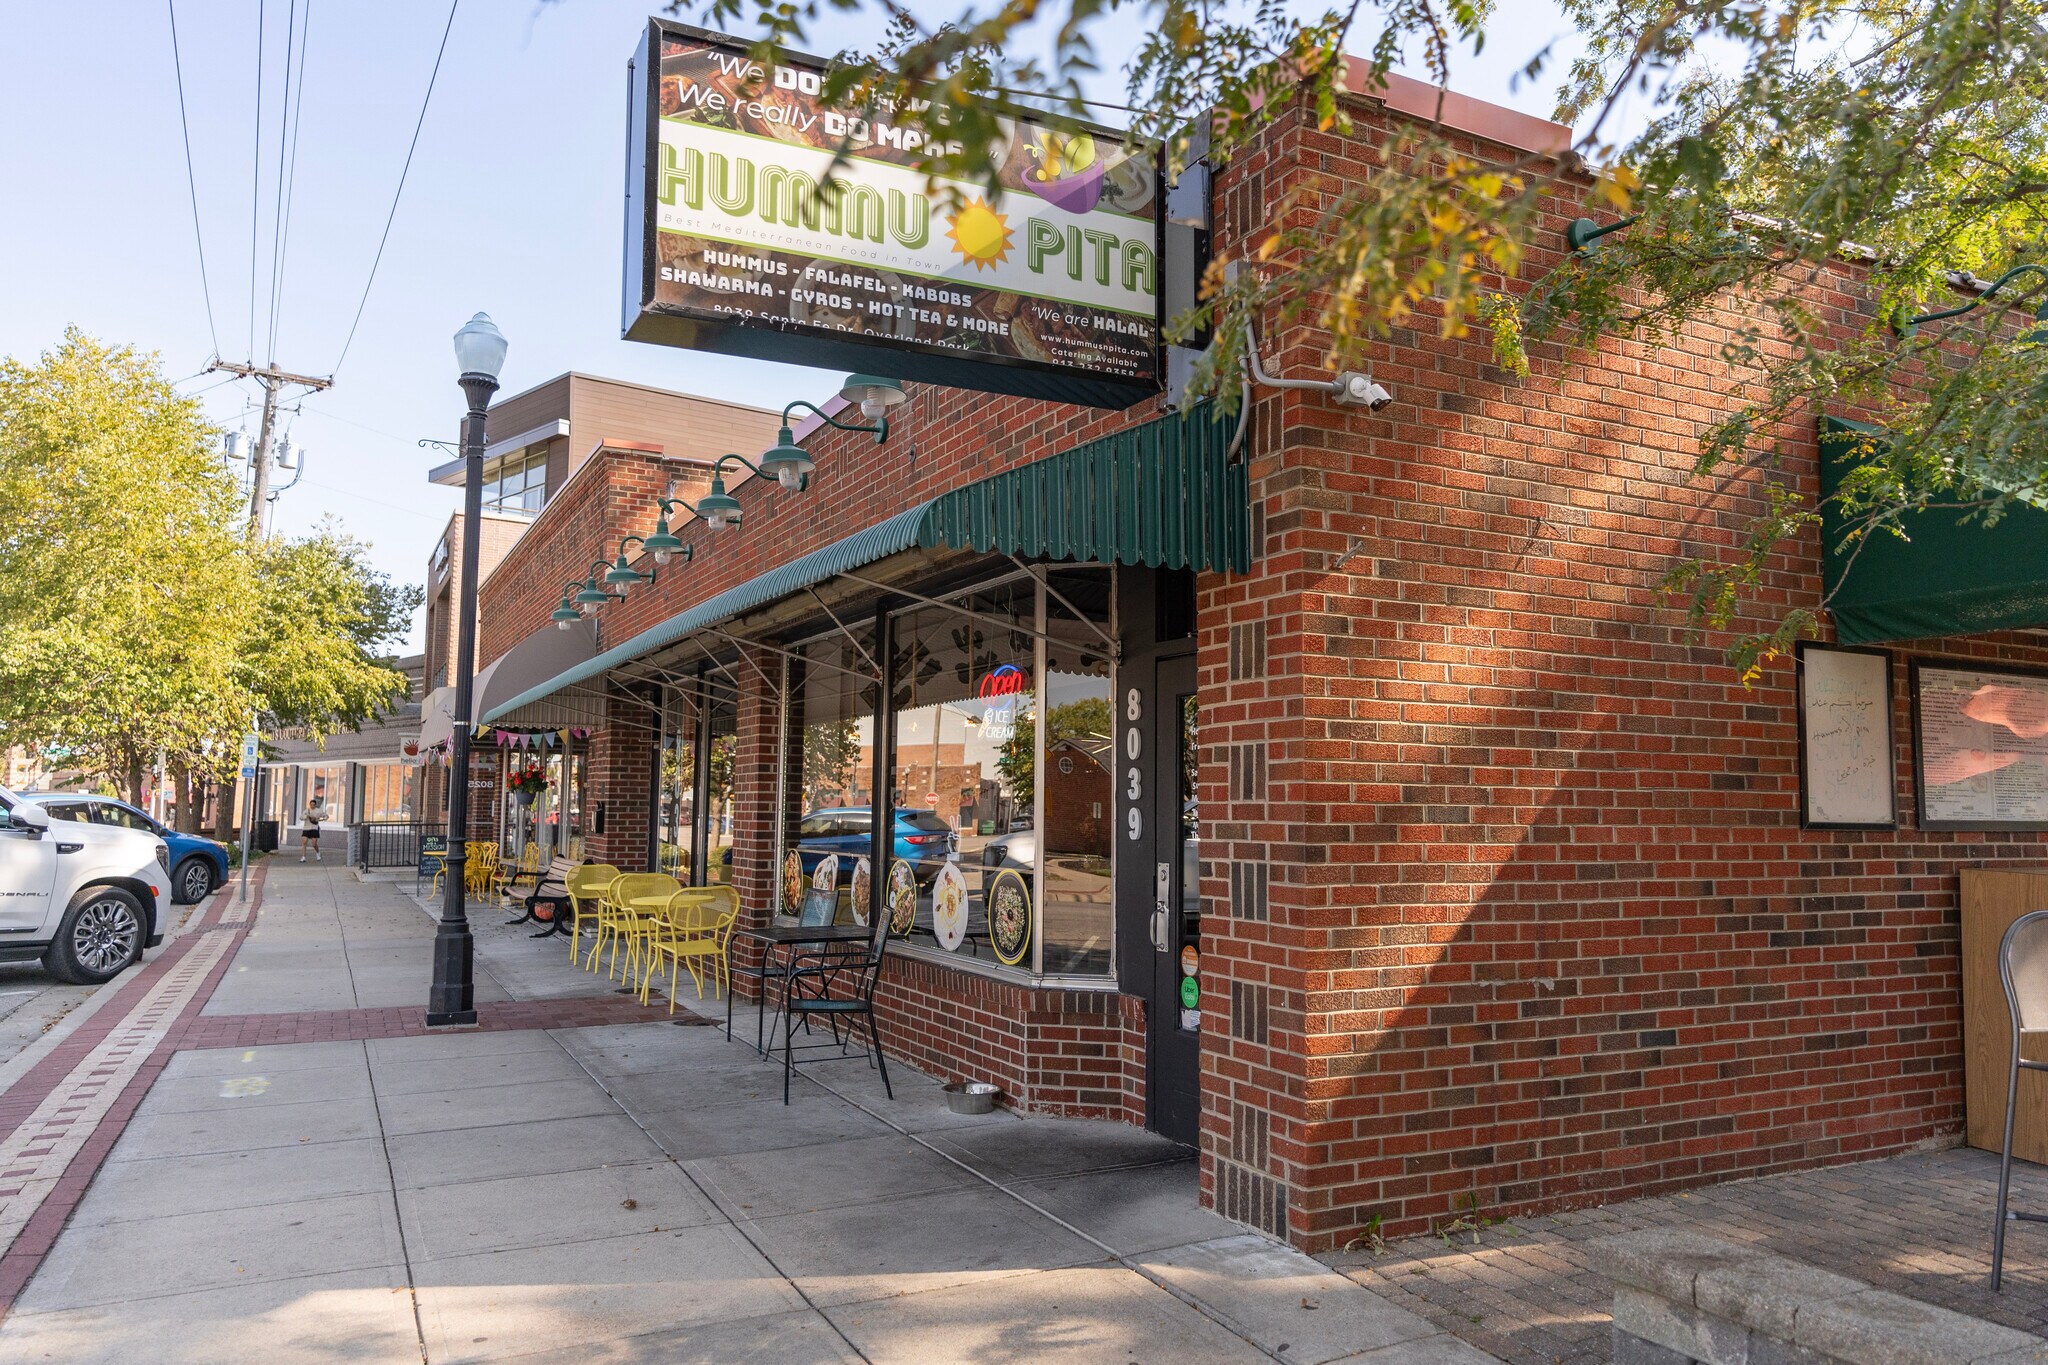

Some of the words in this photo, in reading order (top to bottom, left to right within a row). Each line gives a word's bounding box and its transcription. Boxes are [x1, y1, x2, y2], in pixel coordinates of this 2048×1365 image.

[678, 80, 726, 111] We
[733, 98, 818, 133] really
[824, 111, 869, 142] DO
[663, 213, 701, 229] Best
[711, 221, 832, 251] Mediterranean
[841, 245, 877, 259] Food
[885, 252, 898, 263] in
[907, 257, 941, 271] Town
[1027, 216, 1156, 296] PITA
[660, 267, 773, 297] SHAWARMA
[790, 288, 852, 310] GYROS
[868, 300, 905, 318] HOT
[908, 307, 942, 325] TEA
[946, 314, 959, 327] &
[962, 316, 1009, 336] MORE
[703, 250, 788, 275] HUMMUS
[805, 266, 886, 293] FALAFEL
[902, 283, 972, 308] KABOBS
[760, 312, 806, 326] Santa
[812, 319, 830, 328] Fe
[864, 328, 932, 345] Overland
[1064, 313, 1089, 327] are
[1040, 334, 1149, 358] www.hummusnpita.com
[1051, 347, 1092, 361] Catering
[1095, 354, 1138, 368] Available
[985, 725, 1016, 739] CREAM
[994, 710, 1010, 723] ICE
[1127, 688, 1142, 841] 8039
